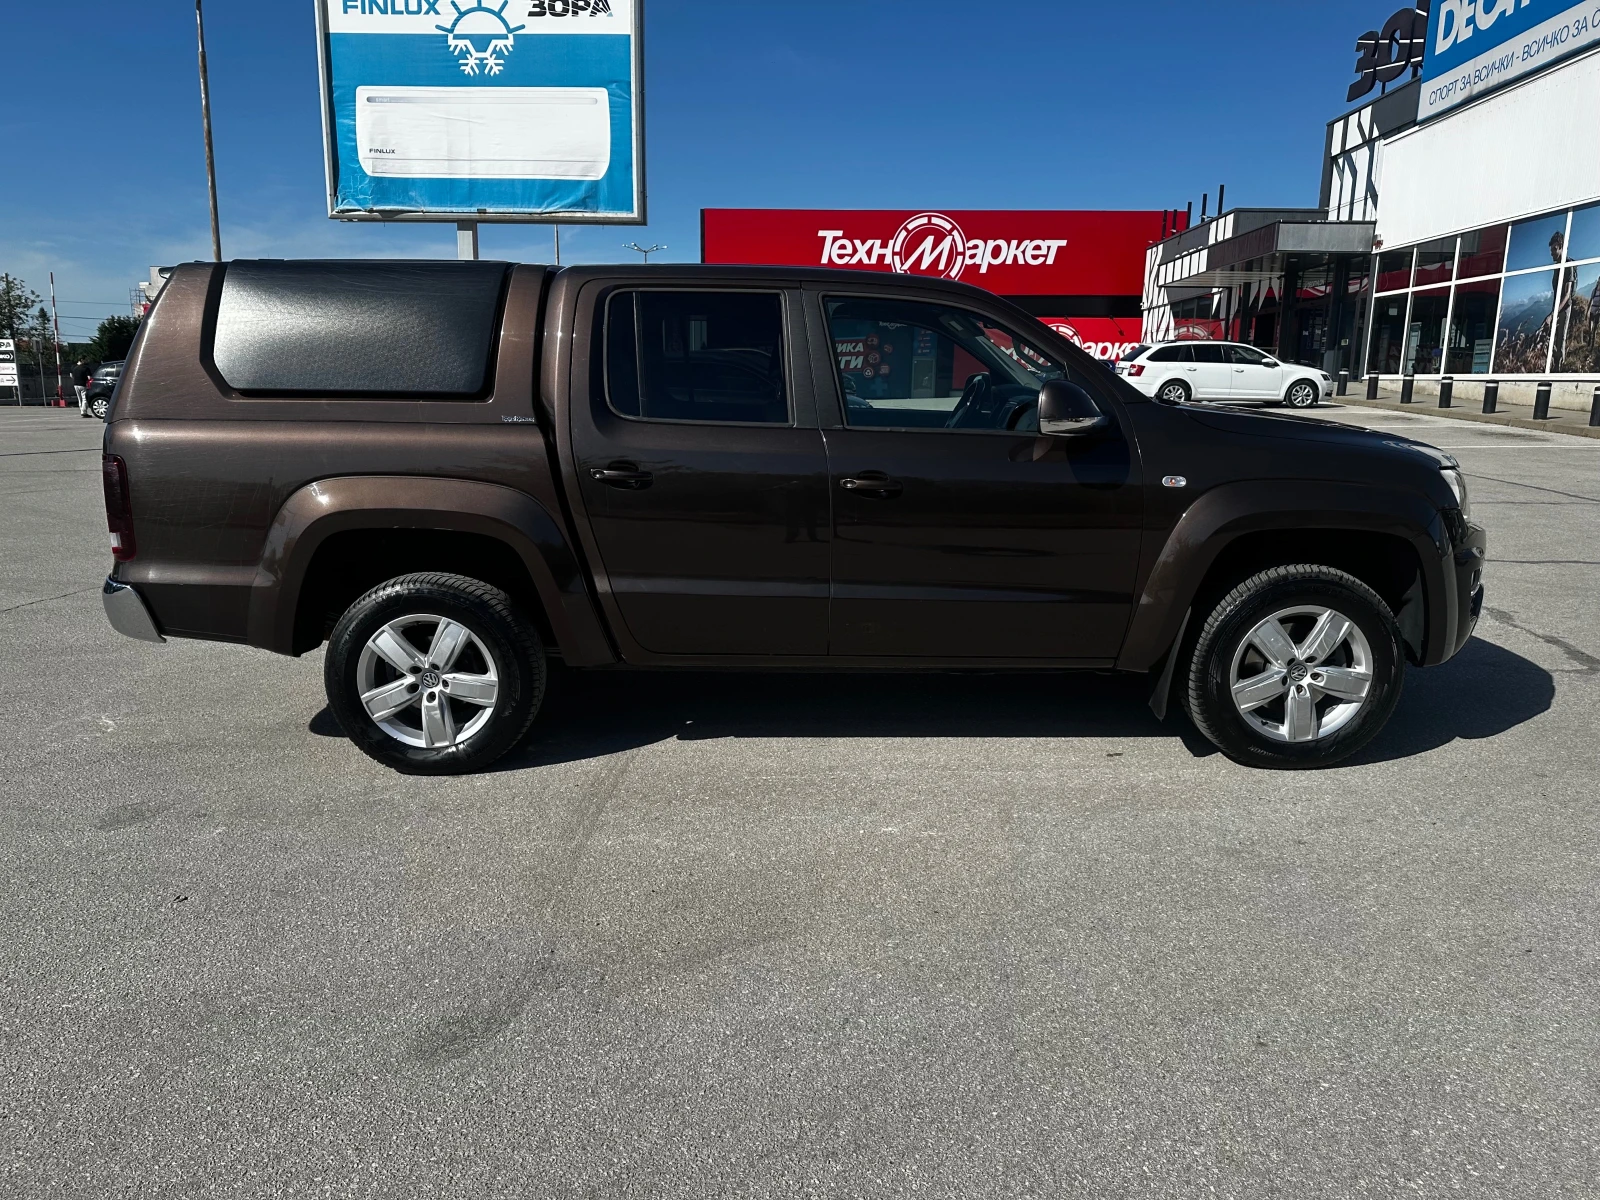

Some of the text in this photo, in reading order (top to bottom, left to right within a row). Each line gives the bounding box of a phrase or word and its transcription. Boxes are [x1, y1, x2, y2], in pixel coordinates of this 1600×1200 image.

[342, 0, 441, 15] FINLUX
[1428, 78, 1459, 106] СПОРТ
[1459, 75, 1472, 91] ЗА
[1473, 51, 1515, 85] ВСИЧКИ
[1522, 25, 1570, 62] ВСИЧКО
[1571, 15, 1588, 38] ЗА
[835, 342, 864, 353] ИКА
[838, 355, 864, 369] ГИ
